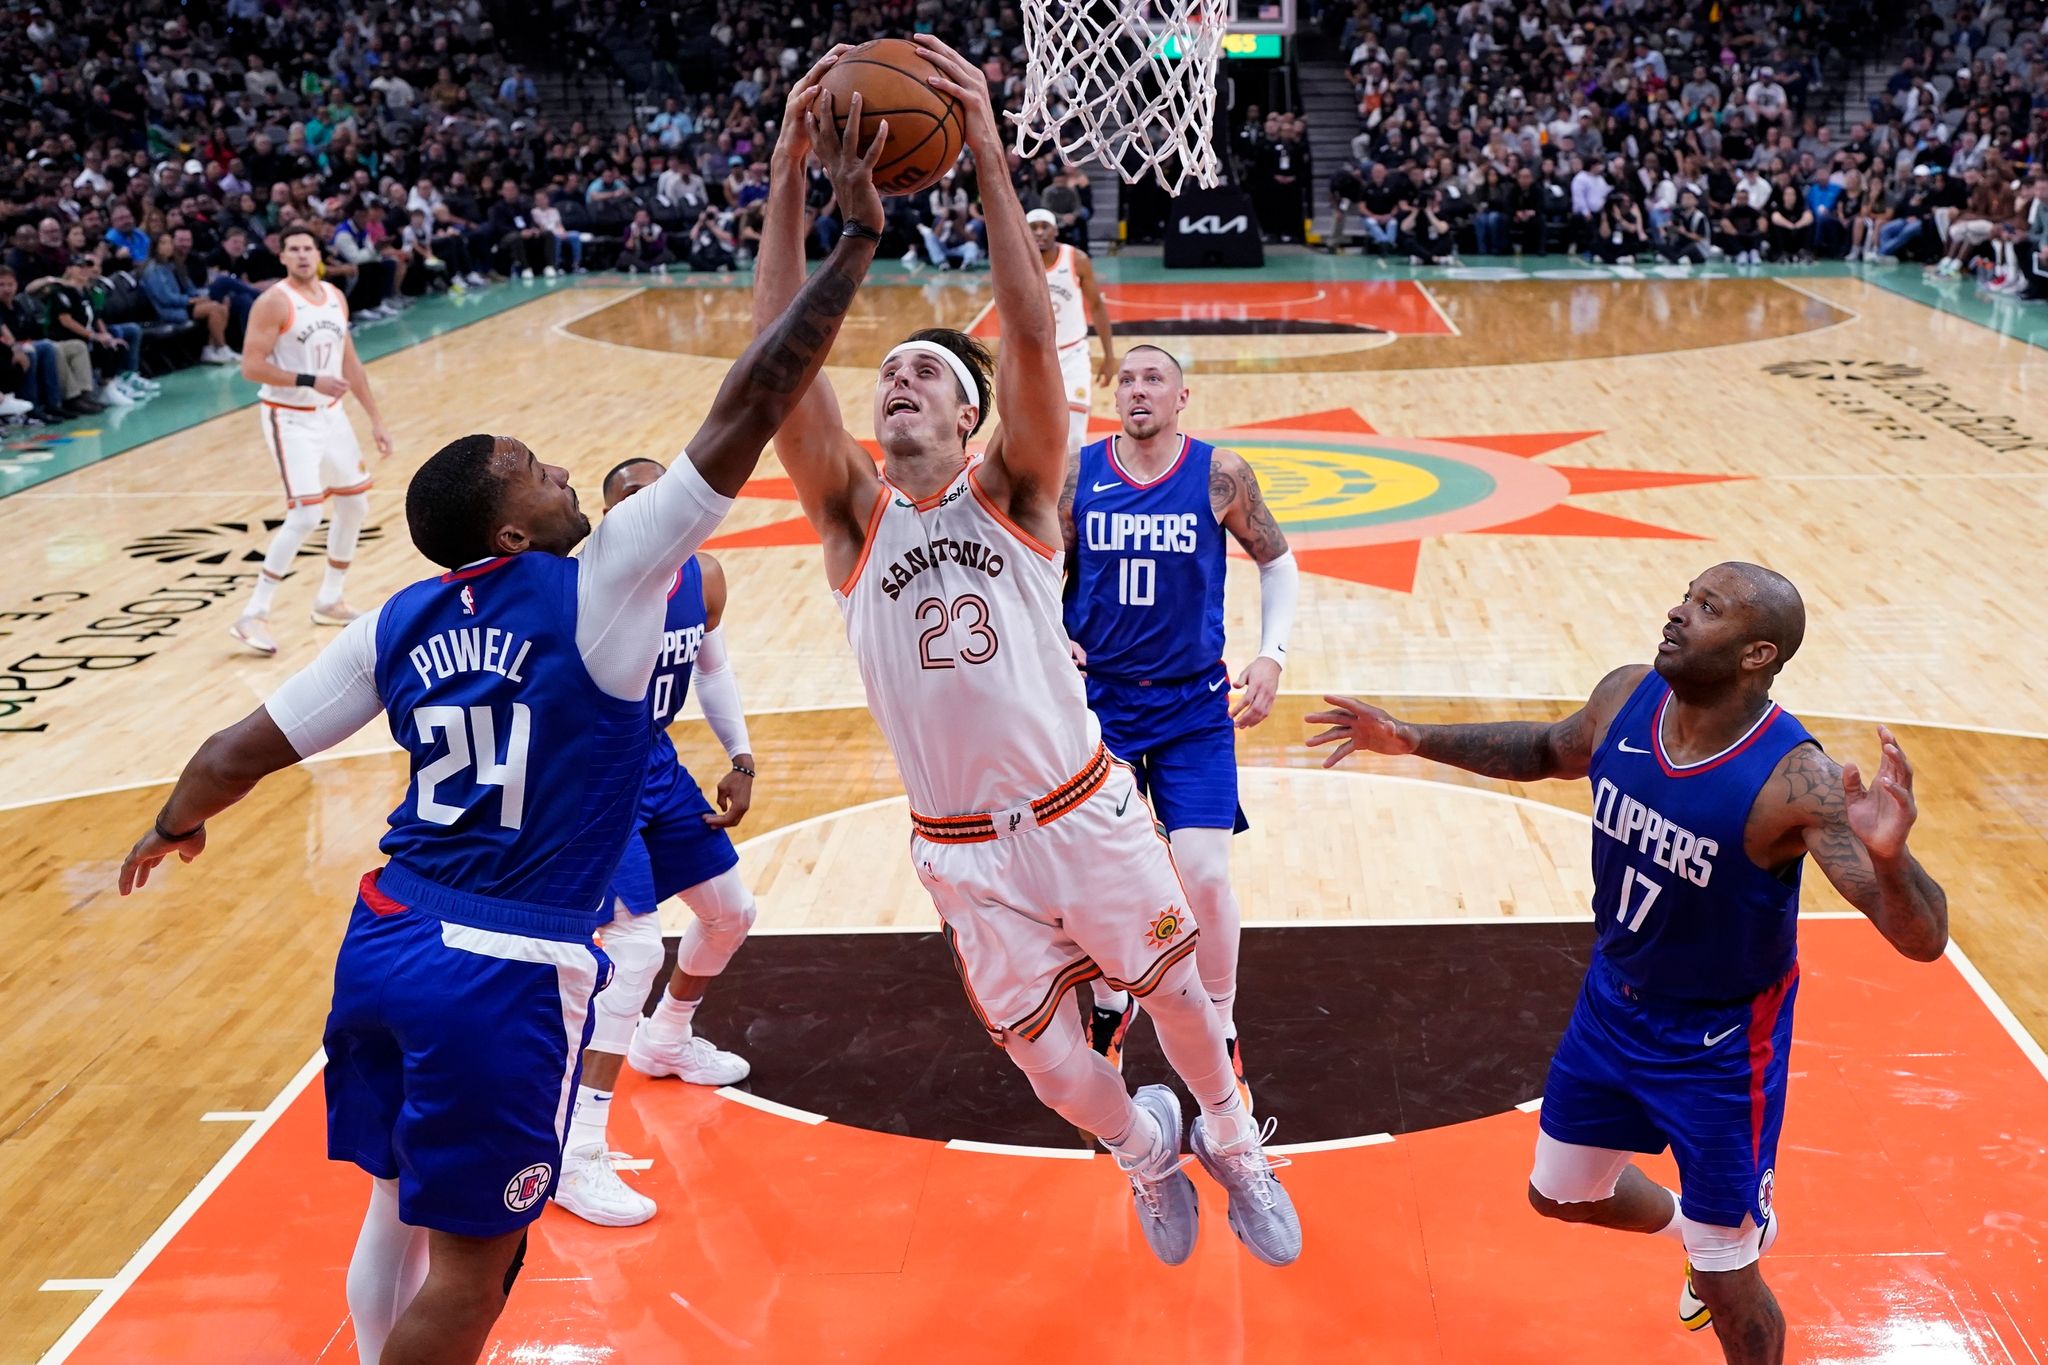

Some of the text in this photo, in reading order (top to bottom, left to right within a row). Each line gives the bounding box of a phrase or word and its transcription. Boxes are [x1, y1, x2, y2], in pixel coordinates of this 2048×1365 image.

[1086, 511, 1198, 553] CLIPPERS
[882, 547, 930, 601] SAN
[1119, 558, 1156, 606] 10
[409, 627, 532, 690] POWELL
[915, 593, 999, 670] 23
[413, 702, 531, 830] 24
[1593, 777, 1719, 888] CLIPPERS
[1616, 865, 1663, 933] 17
